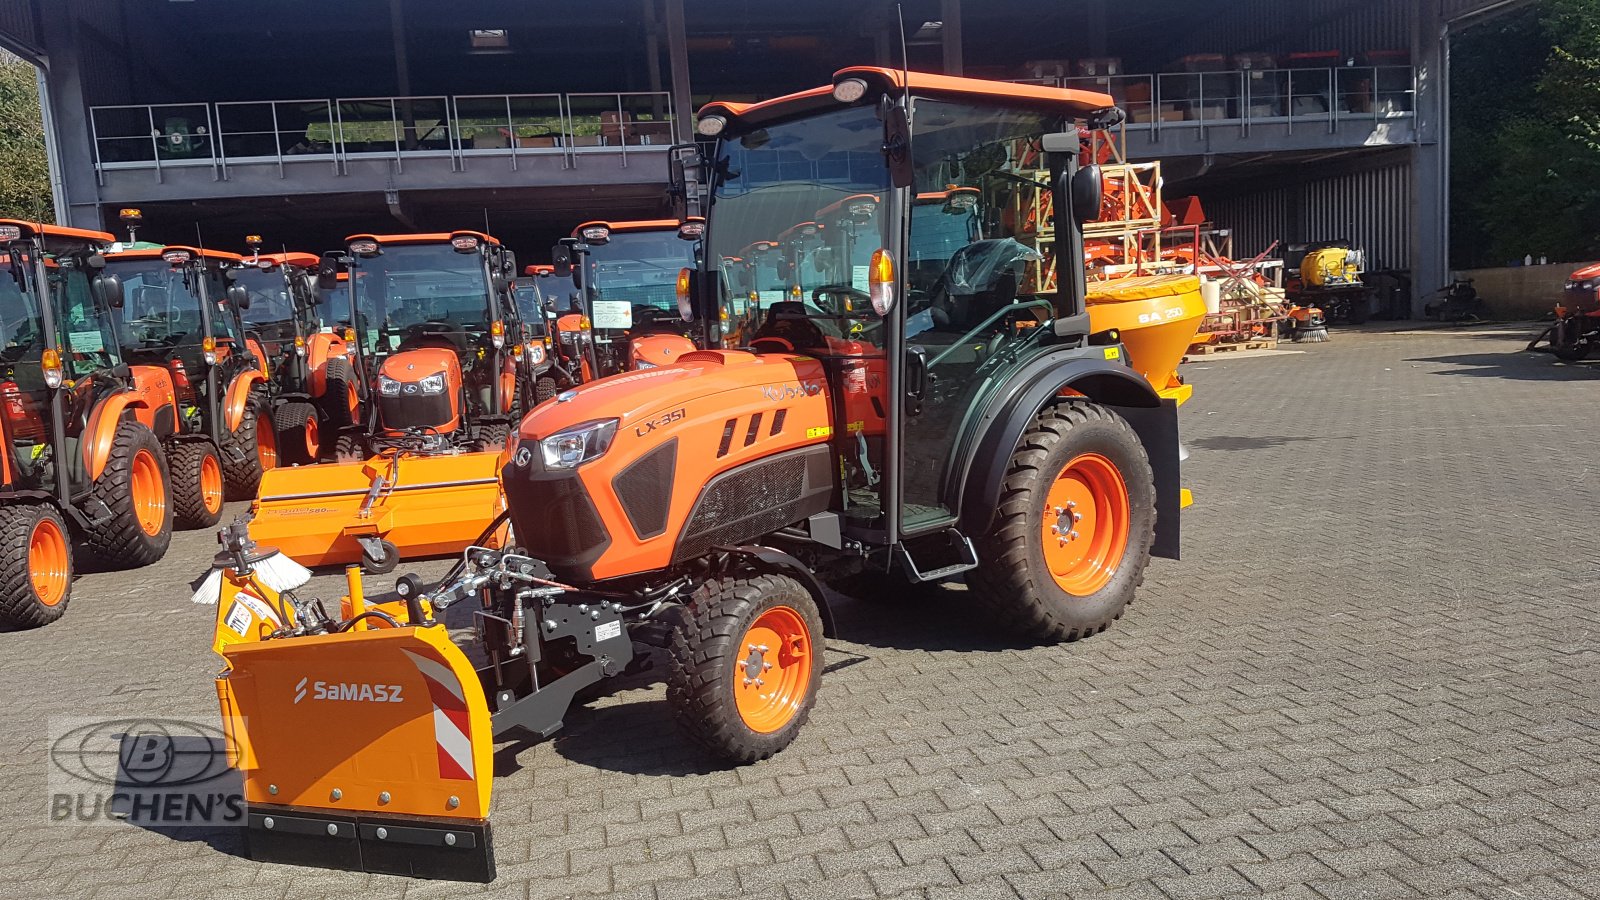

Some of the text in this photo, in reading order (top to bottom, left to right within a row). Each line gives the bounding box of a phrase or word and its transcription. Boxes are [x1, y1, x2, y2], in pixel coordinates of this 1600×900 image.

[1138, 307, 1183, 324] SA 250
[762, 381, 821, 402] Kubota
[635, 408, 686, 438] LX-351
[313, 681, 404, 703] SaMASZ
